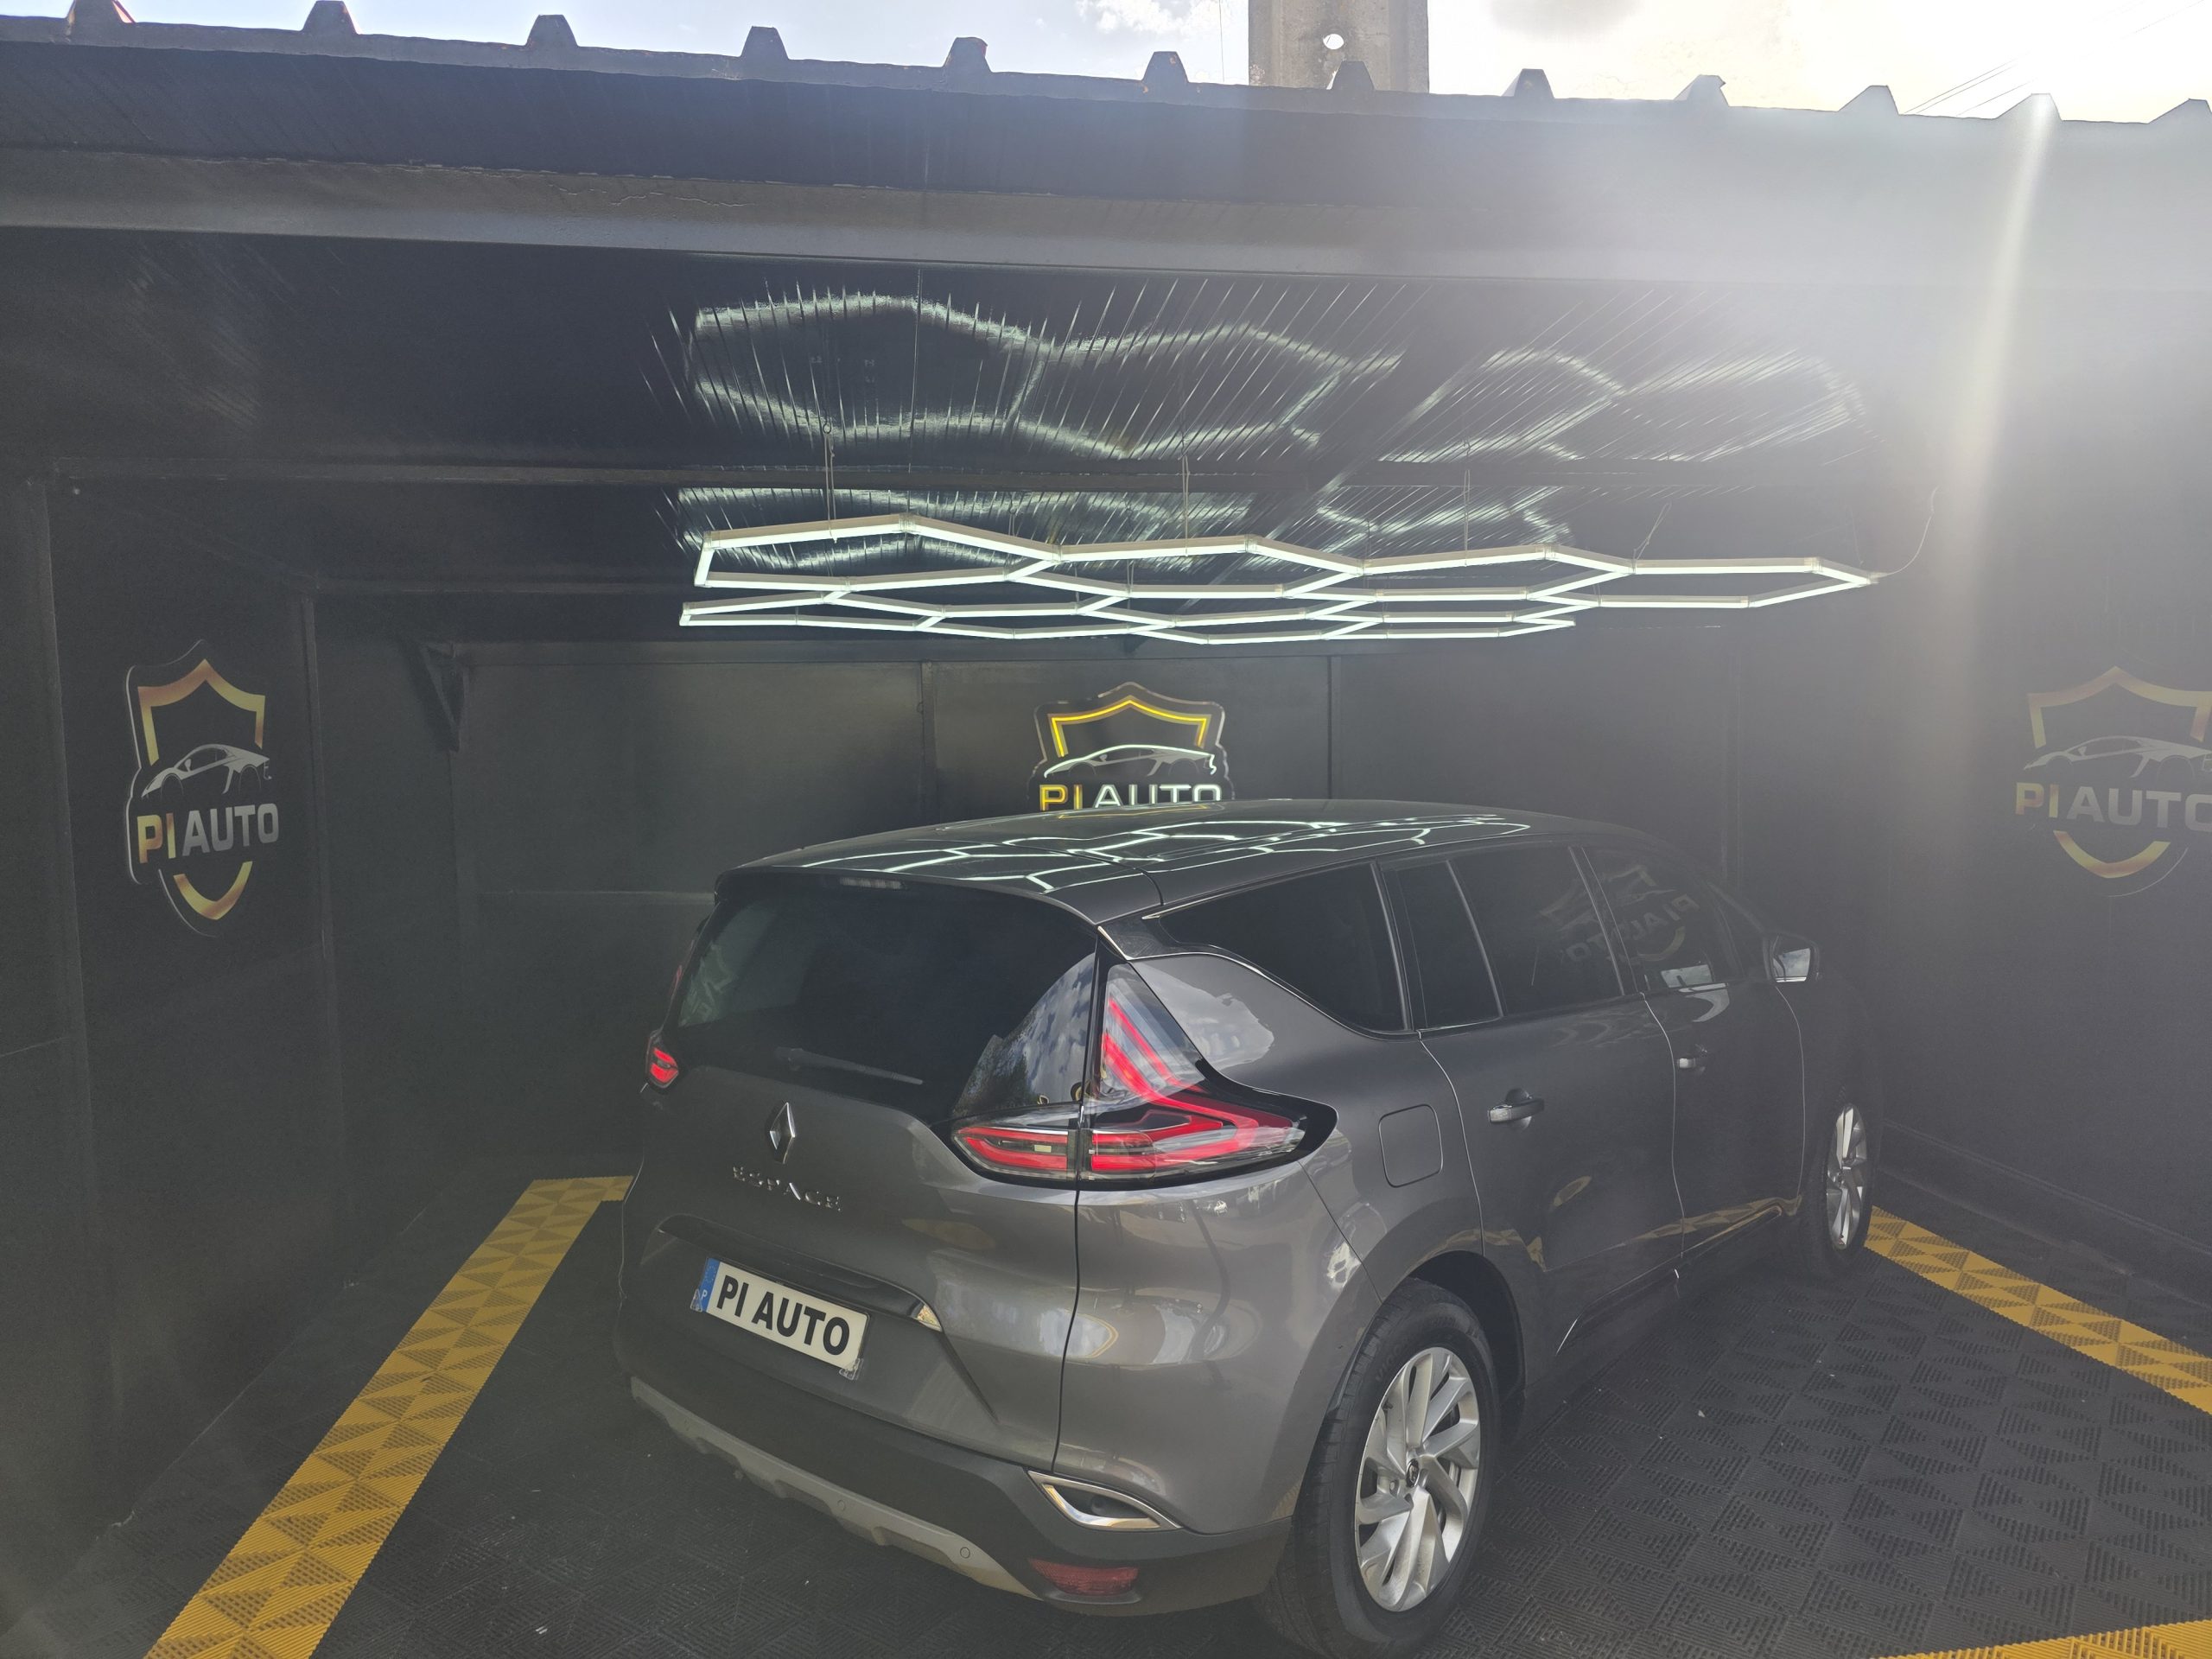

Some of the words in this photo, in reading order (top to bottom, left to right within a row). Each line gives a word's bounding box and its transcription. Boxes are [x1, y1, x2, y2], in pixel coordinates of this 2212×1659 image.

[1039, 784, 1083, 811] PI
[2015, 782, 2059, 818] PI
[2066, 785, 2212, 832] AUTO
[137, 813, 176, 863] PI
[182, 803, 279, 856] AUTO
[701, 1288, 709, 1300] P
[715, 1274, 749, 1317] PI
[751, 1291, 851, 1356] AUTO
